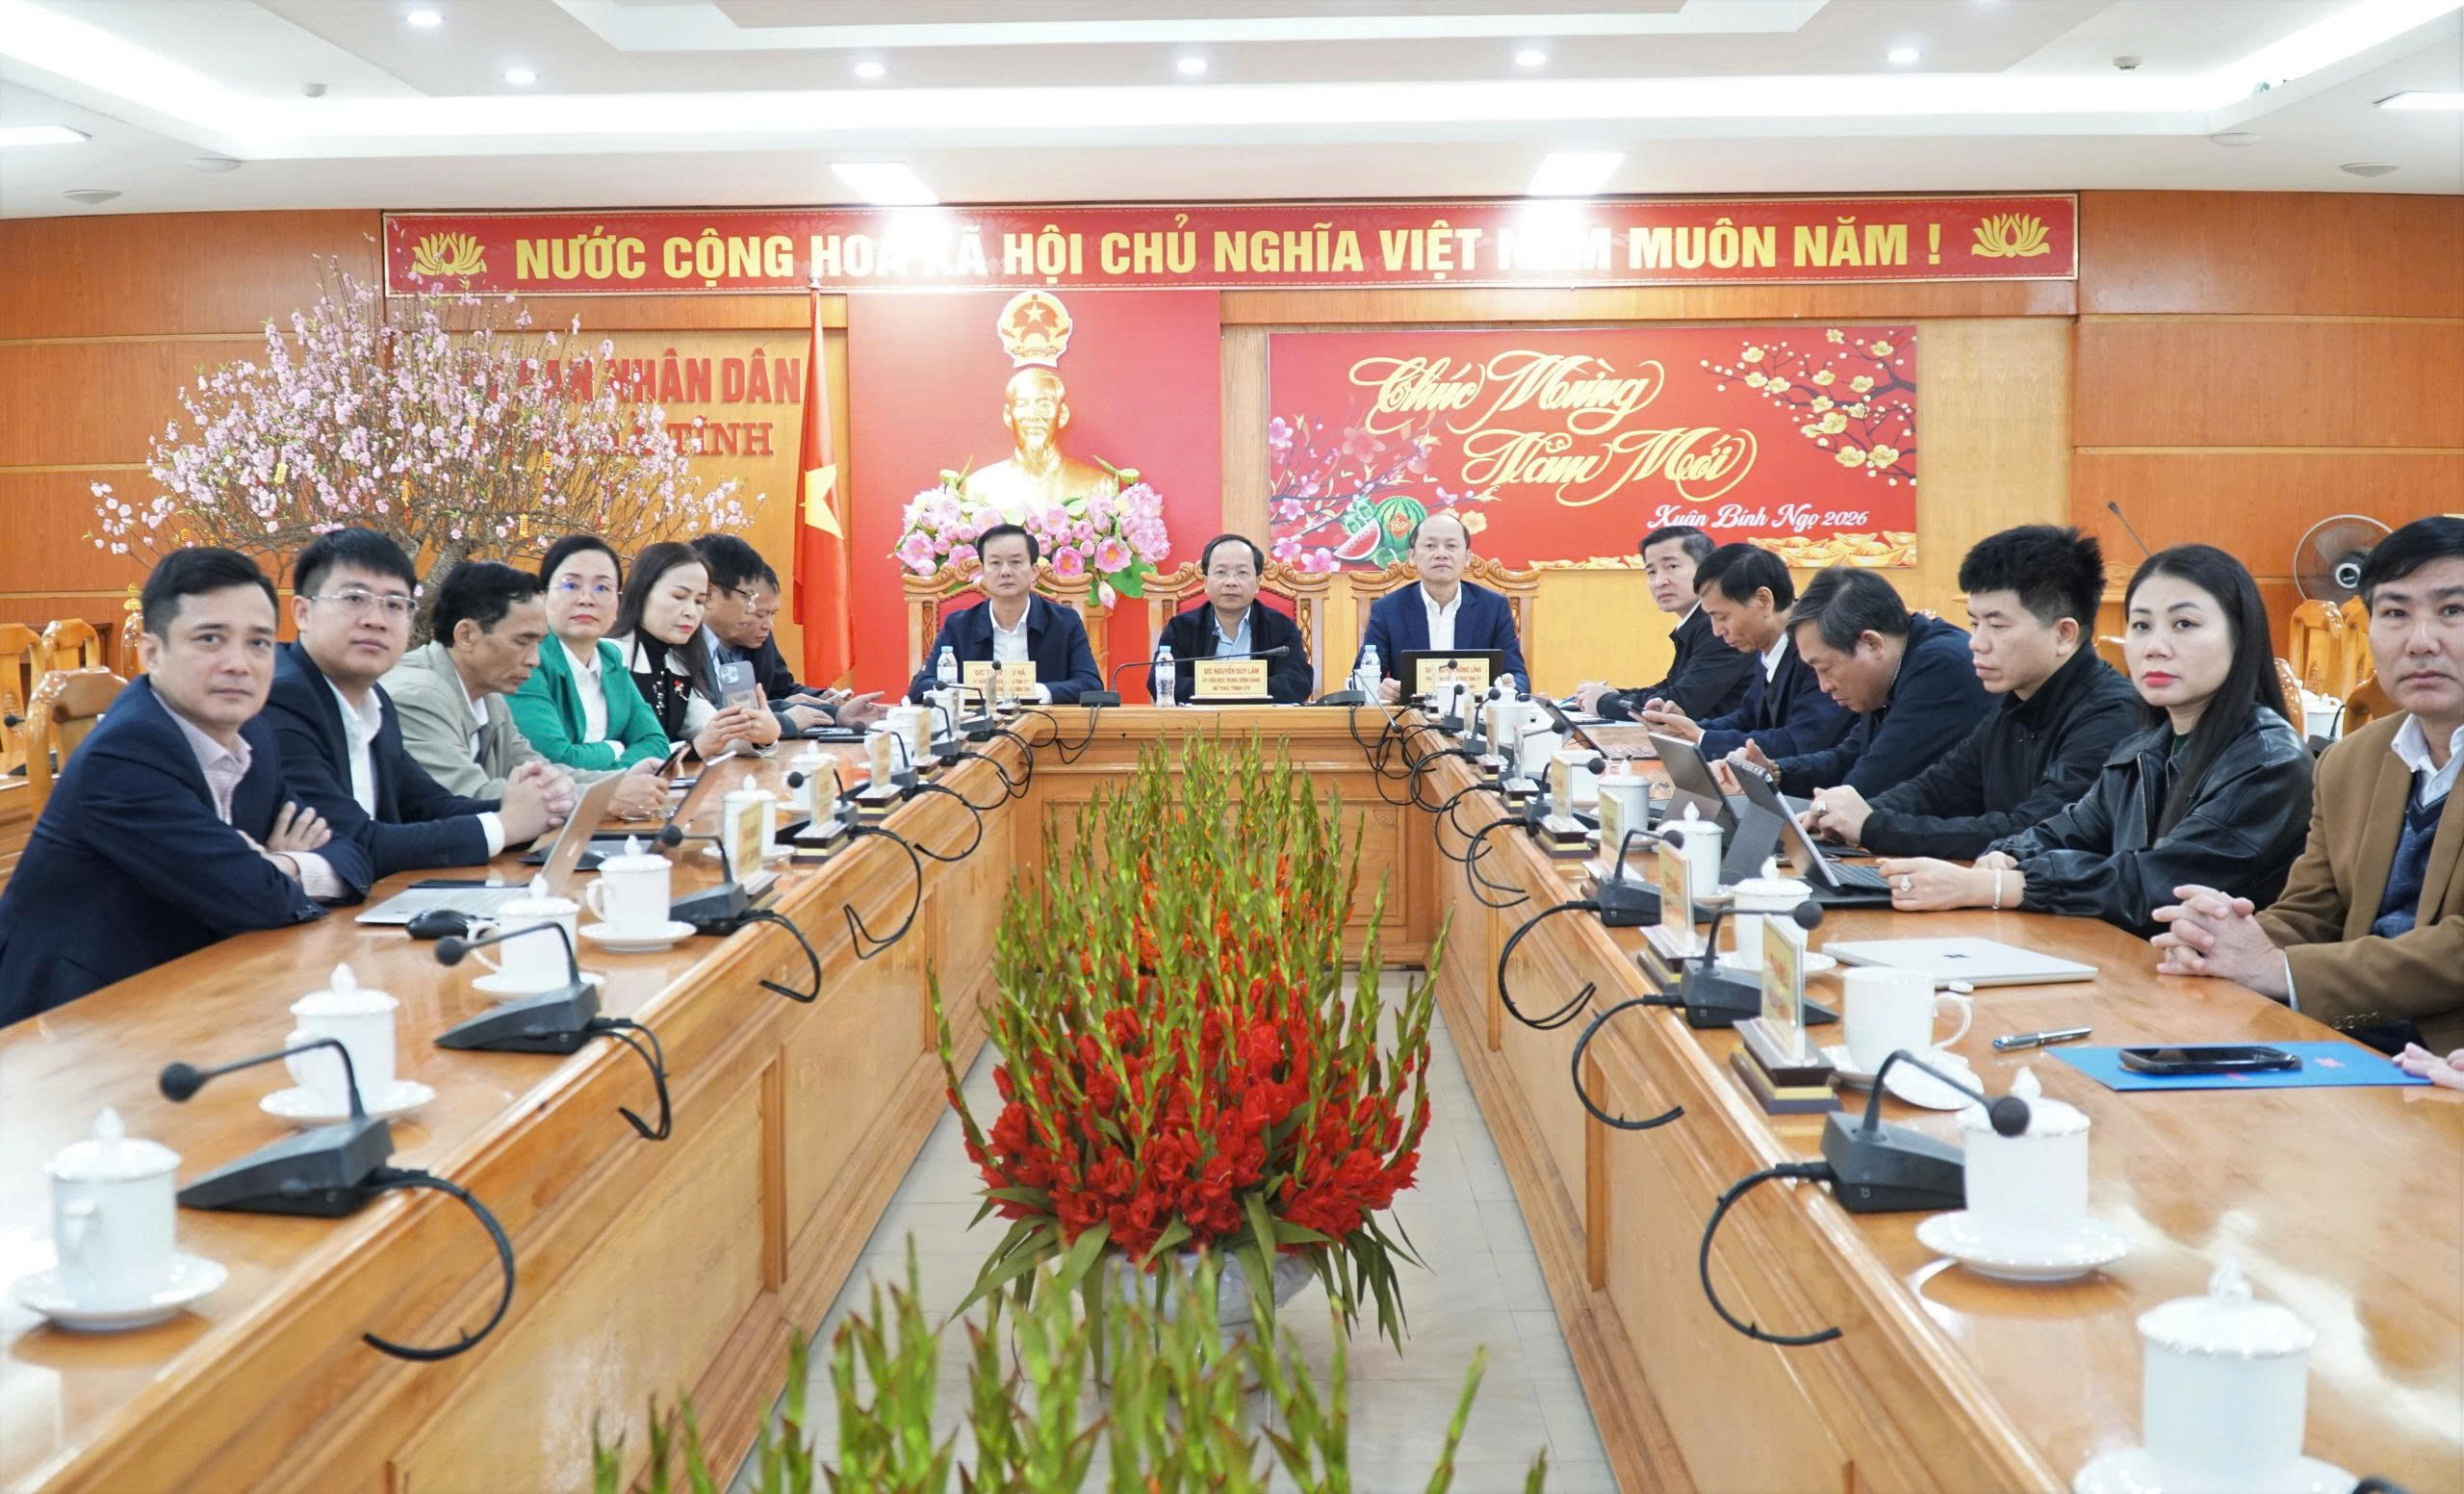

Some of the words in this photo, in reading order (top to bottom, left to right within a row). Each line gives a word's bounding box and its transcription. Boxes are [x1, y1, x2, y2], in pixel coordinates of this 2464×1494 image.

[515, 225, 646, 279] NƯỚC
[663, 227, 794, 287] CỘNG
[1003, 224, 1083, 284] HỘI
[1100, 214, 1196, 274] CHỦ
[1214, 221, 1365, 272] NGHĨA
[1378, 219, 1482, 280] VIỆT
[1629, 217, 1776, 270] MUÔN
[1793, 216, 1908, 267] NĂM
[1928, 223, 1940, 265] !
[605, 348, 711, 402] NHÂN
[723, 348, 801, 402] DÂN
[1349, 357, 1485, 434] Chúc
[1447, 349, 1664, 435] Mừng
[1461, 428, 1613, 485] Năm
[1556, 427, 1758, 507] Mới
[1647, 503, 1709, 528] Xuân
[1711, 503, 1768, 528] Bính
[1771, 503, 1821, 532] Ngọ
[1822, 510, 1870, 526] 2026
